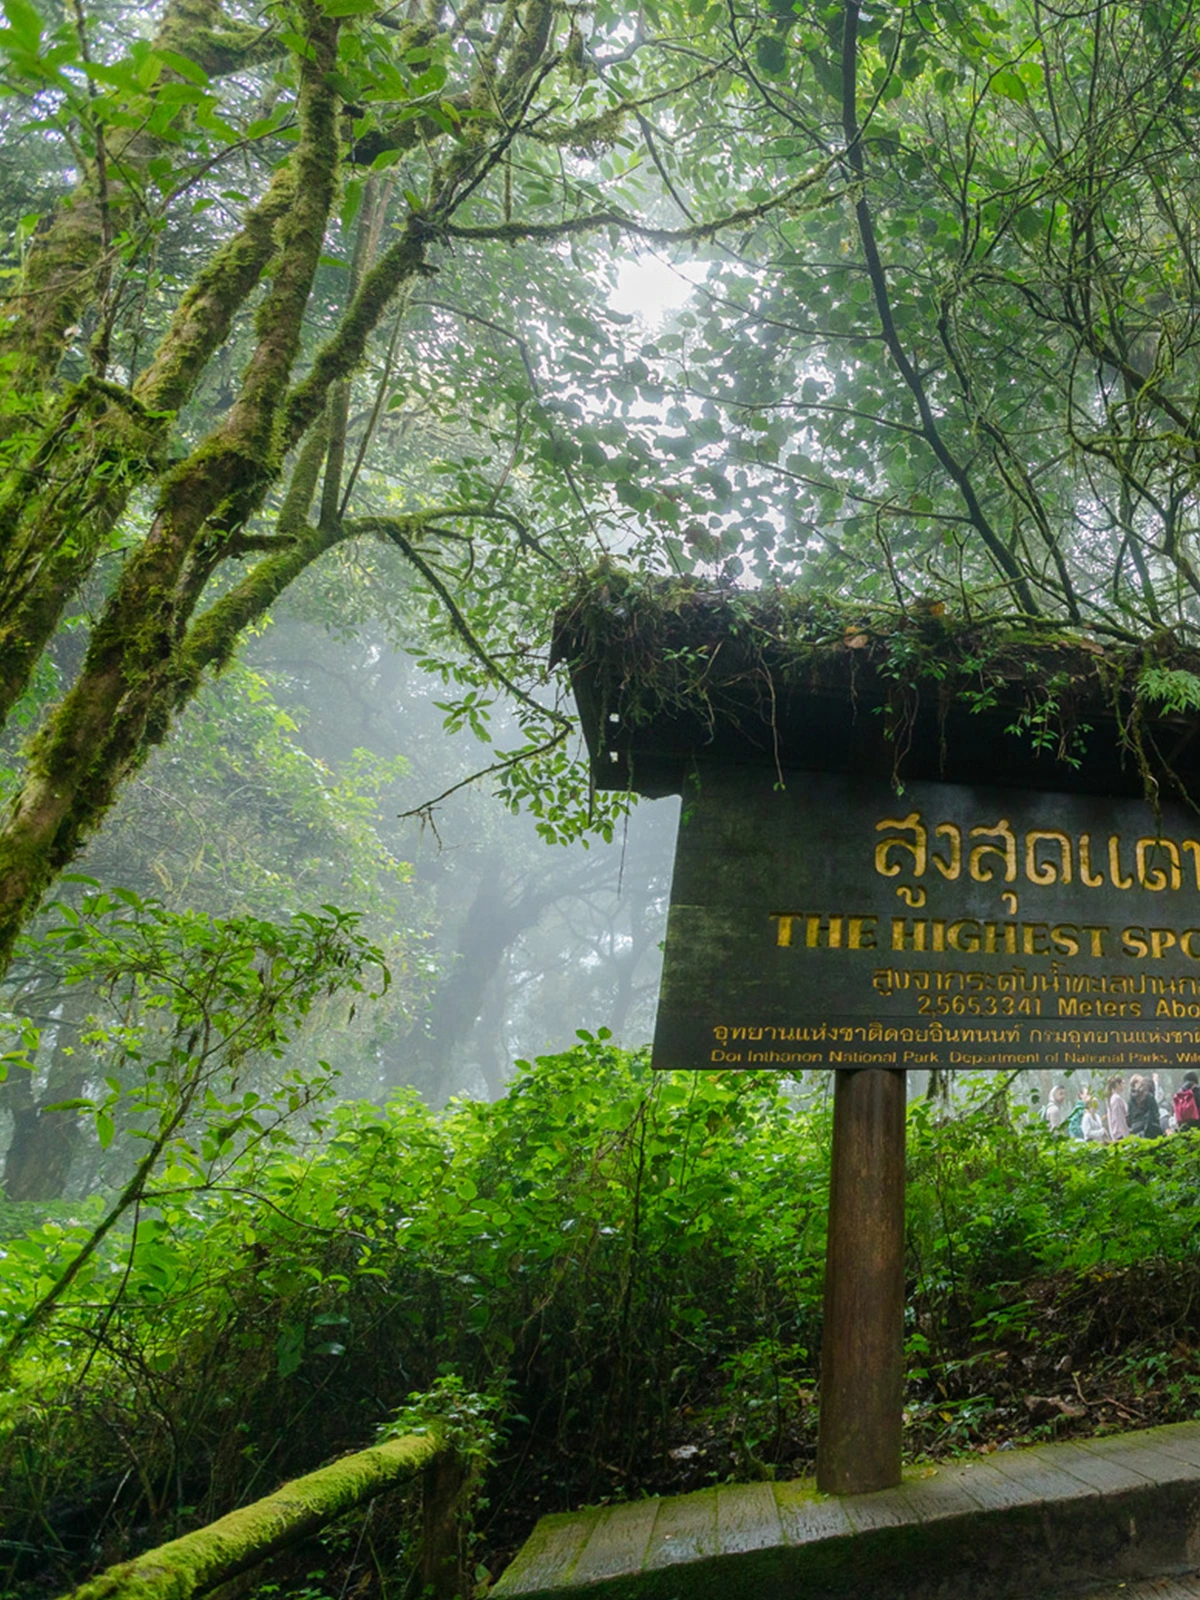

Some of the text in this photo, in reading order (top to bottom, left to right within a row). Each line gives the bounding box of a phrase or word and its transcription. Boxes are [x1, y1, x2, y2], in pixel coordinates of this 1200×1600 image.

[769, 912, 879, 949] THE
[891, 917, 1110, 957] HIGHEST
[1058, 997, 1142, 1017] Meters
[713, 1021, 1023, 1047] อุทยานแห่งชาติดอยอินทนนท์
[711, 1050, 741, 1062] Doi
[747, 1051, 822, 1063] Inthanon
[829, 1051, 896, 1063] National
[950, 1051, 1040, 1065] Department
[1045, 1052, 1059, 1063] of
[1065, 1052, 1125, 1064] National
